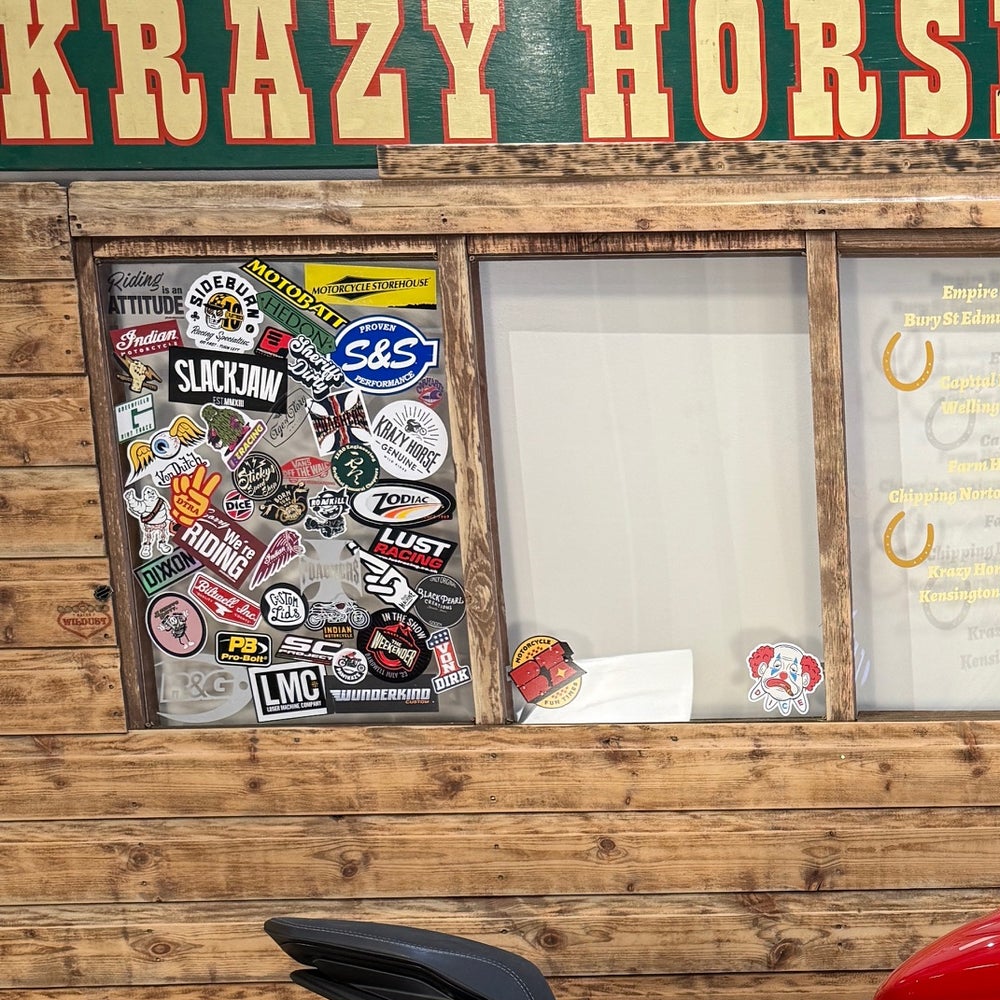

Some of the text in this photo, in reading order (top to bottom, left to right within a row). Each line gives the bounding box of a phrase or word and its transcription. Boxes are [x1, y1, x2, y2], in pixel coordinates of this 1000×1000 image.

[0, 0, 500, 145] KRAZY
[108, 270, 164, 294] Riding
[312, 278, 430, 295] MOTORCYCLE STOREHOUSE
[189, 275, 260, 320] SIDEBURN
[247, 259, 348, 329] MOTOBATT
[942, 284, 998, 302] Empire
[108, 296, 185, 315] ATTITUDE
[359, 323, 397, 334] PROVEN
[904, 312, 942, 330] Bury
[942, 312, 960, 326] St
[116, 326, 178, 351] Indian
[342, 336, 419, 371] S&S
[174, 359, 284, 403] SLACKJAW
[354, 370, 416, 388] PERFORMANCE
[940, 373, 996, 392] Capital
[213, 396, 224, 405] EST
[373, 415, 410, 450] KRAZY
[406, 439, 442, 474] HORSE
[292, 458, 312, 469] VANS
[381, 443, 418, 472] GENUINE
[947, 459, 988, 474] Farm
[296, 466, 310, 476] THE
[176, 496, 200, 516] DTRA
[372, 492, 430, 516] ZODIAC
[888, 488, 957, 506] Chipping
[180, 522, 249, 580] RIDING
[380, 528, 451, 558] LUST
[374, 542, 444, 569] RACING
[142, 552, 196, 589] DIXXON
[928, 562, 971, 580] Krazy
[418, 588, 440, 602] BLACK
[440, 594, 464, 605] PEARL
[919, 587, 1000, 605] Kensington
[272, 605, 302, 624] Lids
[382, 613, 392, 622] IN
[392, 612, 406, 624] THE
[407, 617, 426, 640] SHOW
[228, 636, 258, 654] PB
[278, 648, 333, 660] PROJECT
[284, 636, 342, 656] SC
[370, 630, 418, 668] WEEKENDER
[514, 638, 552, 664] MOTORCYCLE
[221, 653, 265, 663] Pro-Bolt
[436, 641, 457, 675] VON
[260, 670, 320, 706] LMC
[436, 669, 470, 691] DIRK
[334, 688, 431, 702] WUNDERKIND
[544, 682, 580, 706] FUN TIMES
